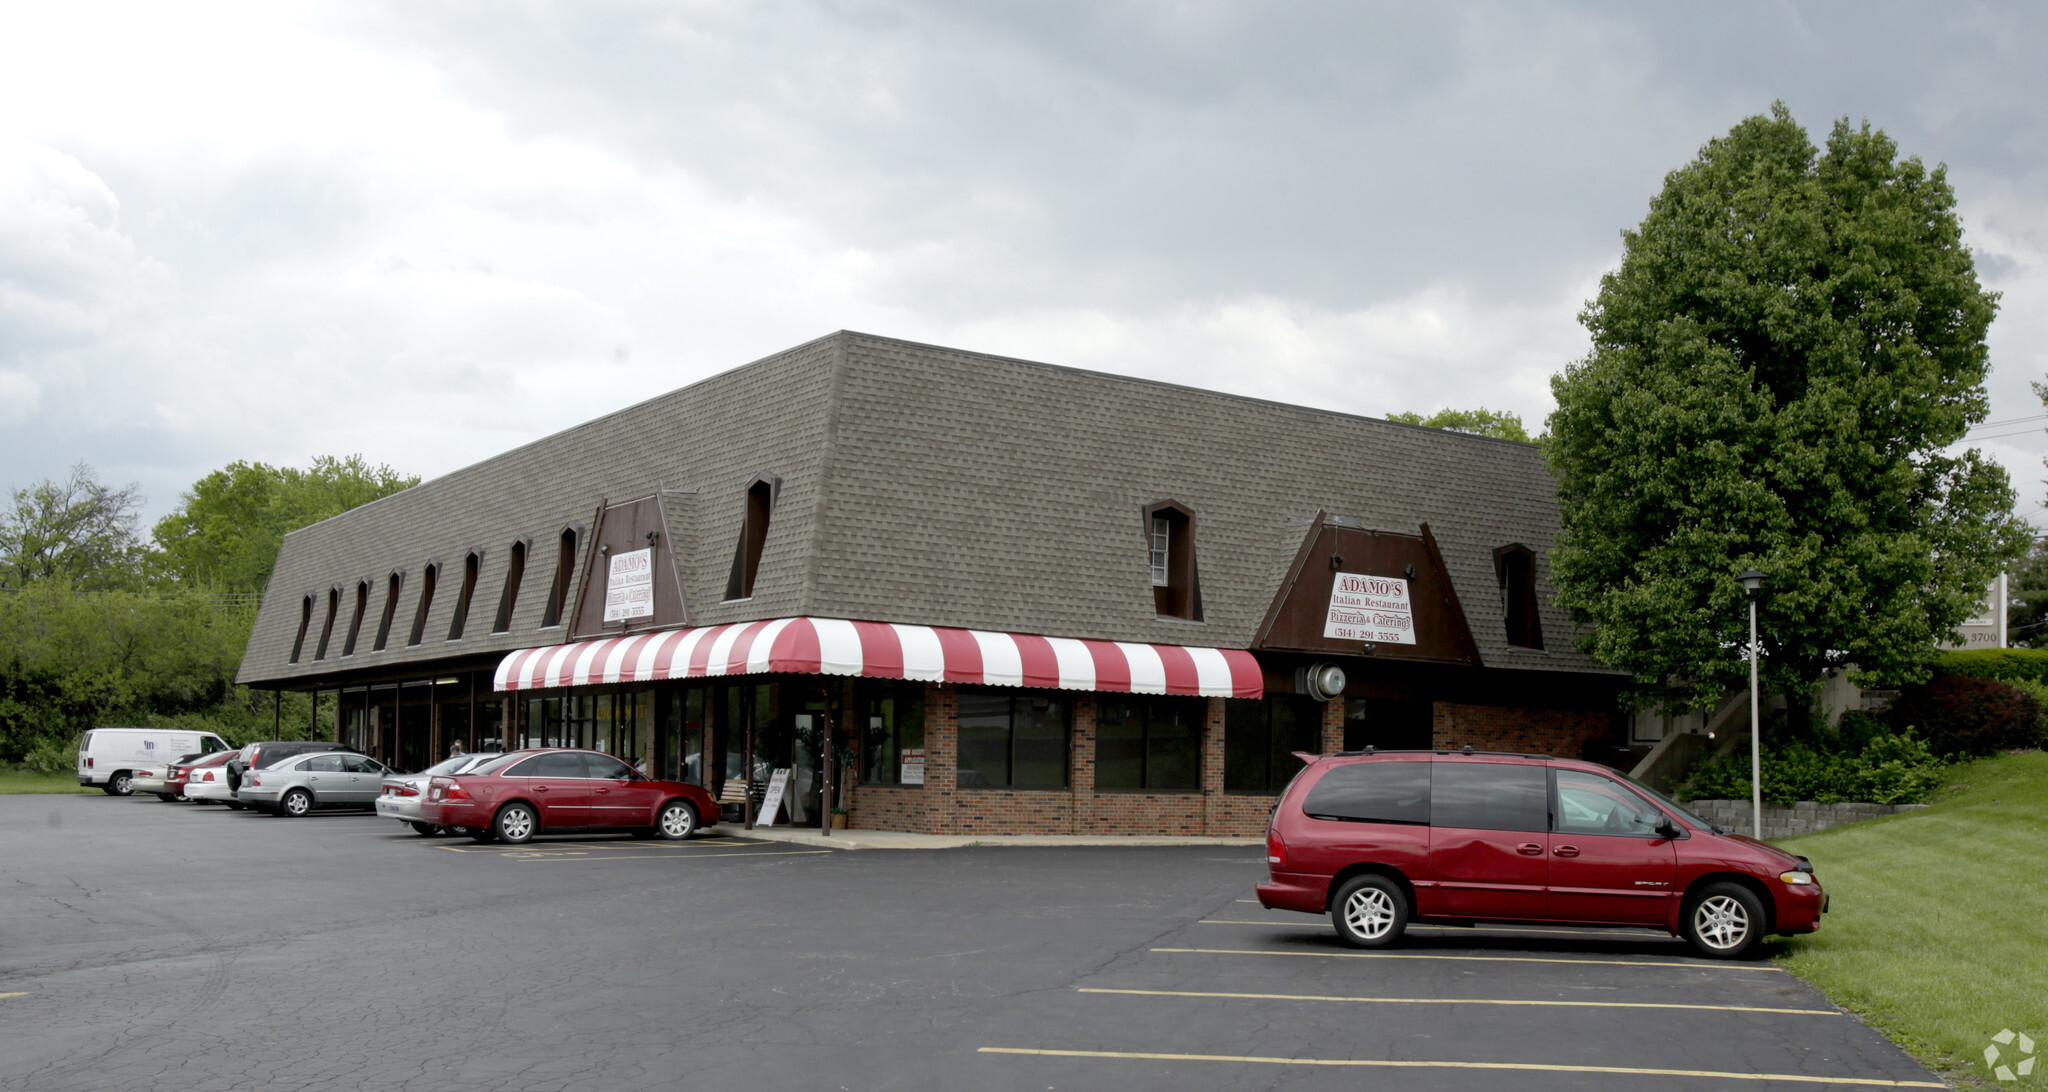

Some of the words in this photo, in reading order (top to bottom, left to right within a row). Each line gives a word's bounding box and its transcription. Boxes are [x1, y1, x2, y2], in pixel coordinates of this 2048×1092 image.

[612, 552, 648, 575] ADAMO'S
[1339, 577, 1403, 598] ADAMO'S
[1333, 594, 1361, 606] Italian
[1365, 598, 1408, 610] Restaurant
[1330, 610, 1365, 625] Pizzeria
[1334, 627, 1356, 638] (314)
[1971, 633, 1997, 642] 3700
